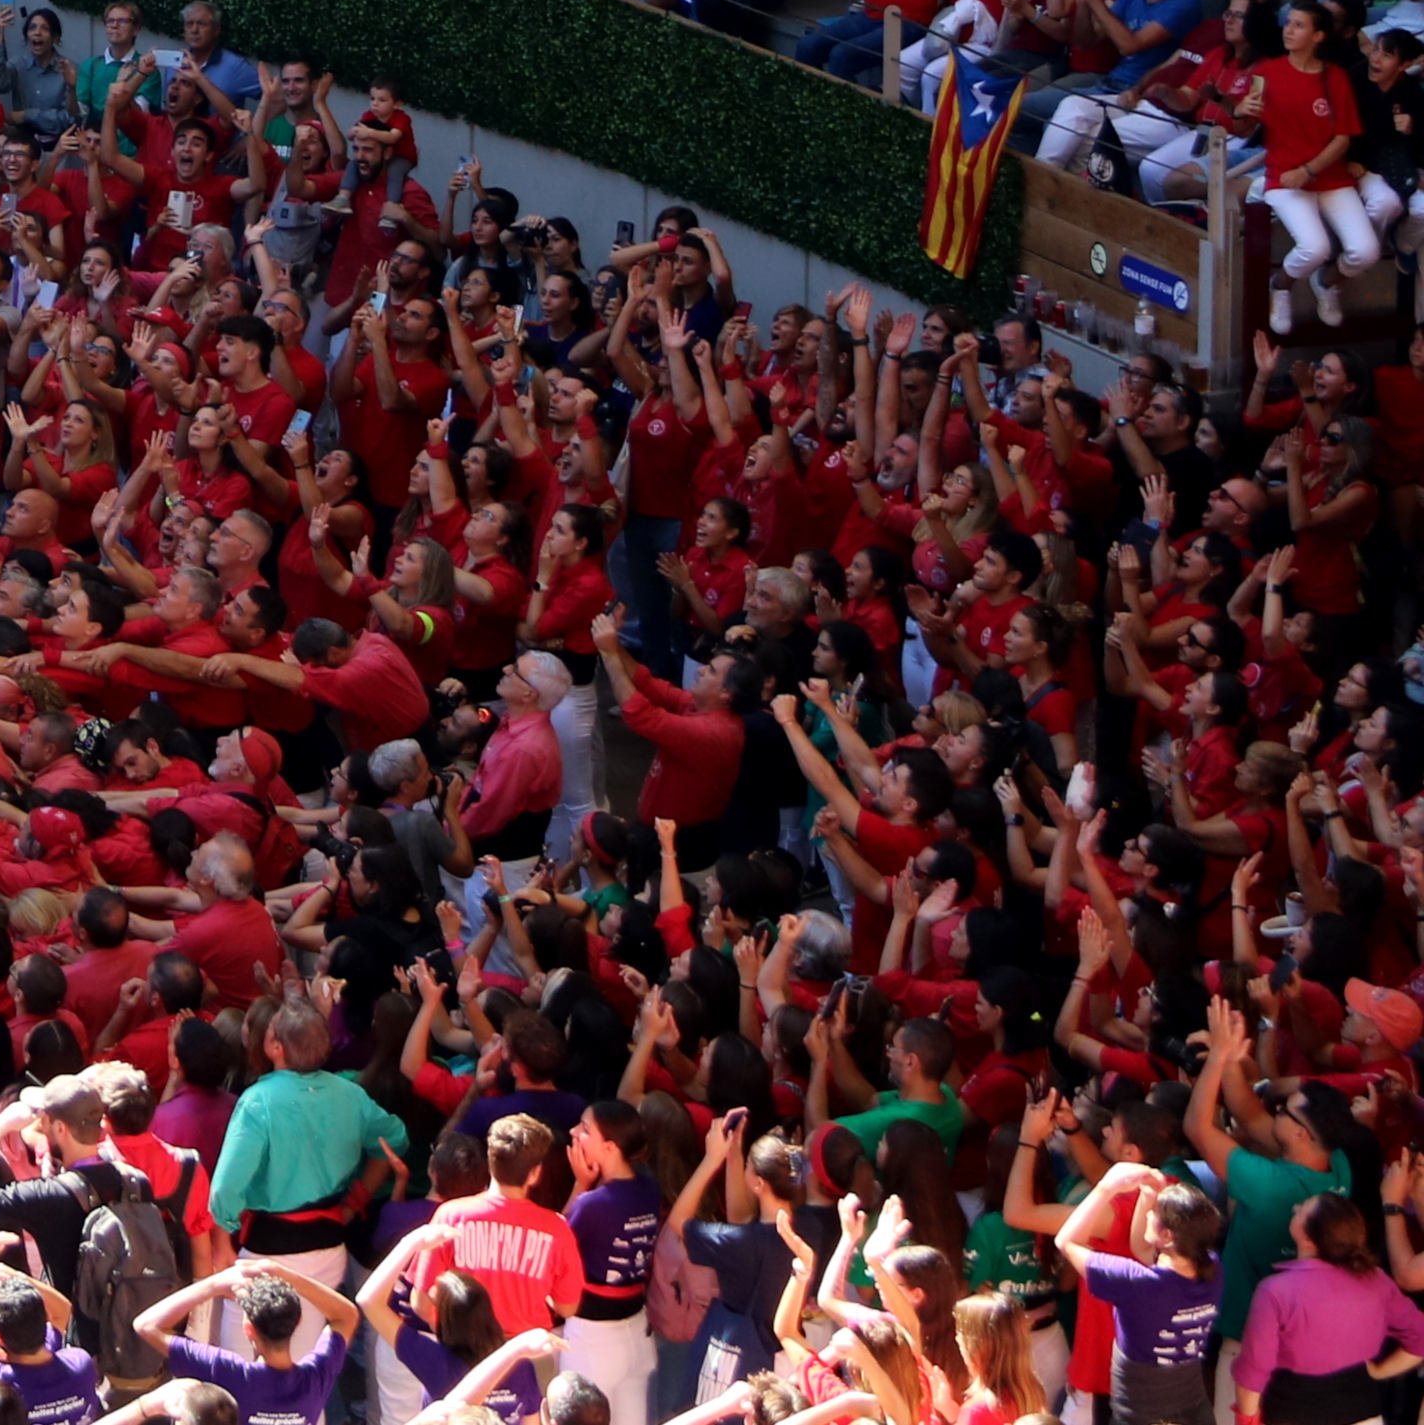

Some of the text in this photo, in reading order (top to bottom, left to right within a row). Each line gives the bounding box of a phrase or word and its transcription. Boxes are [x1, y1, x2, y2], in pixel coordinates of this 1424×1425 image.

[1121, 266, 1140, 281] ZONA
[1140, 273, 1159, 290] SENSE
[519, 1228, 553, 1280] PIT
